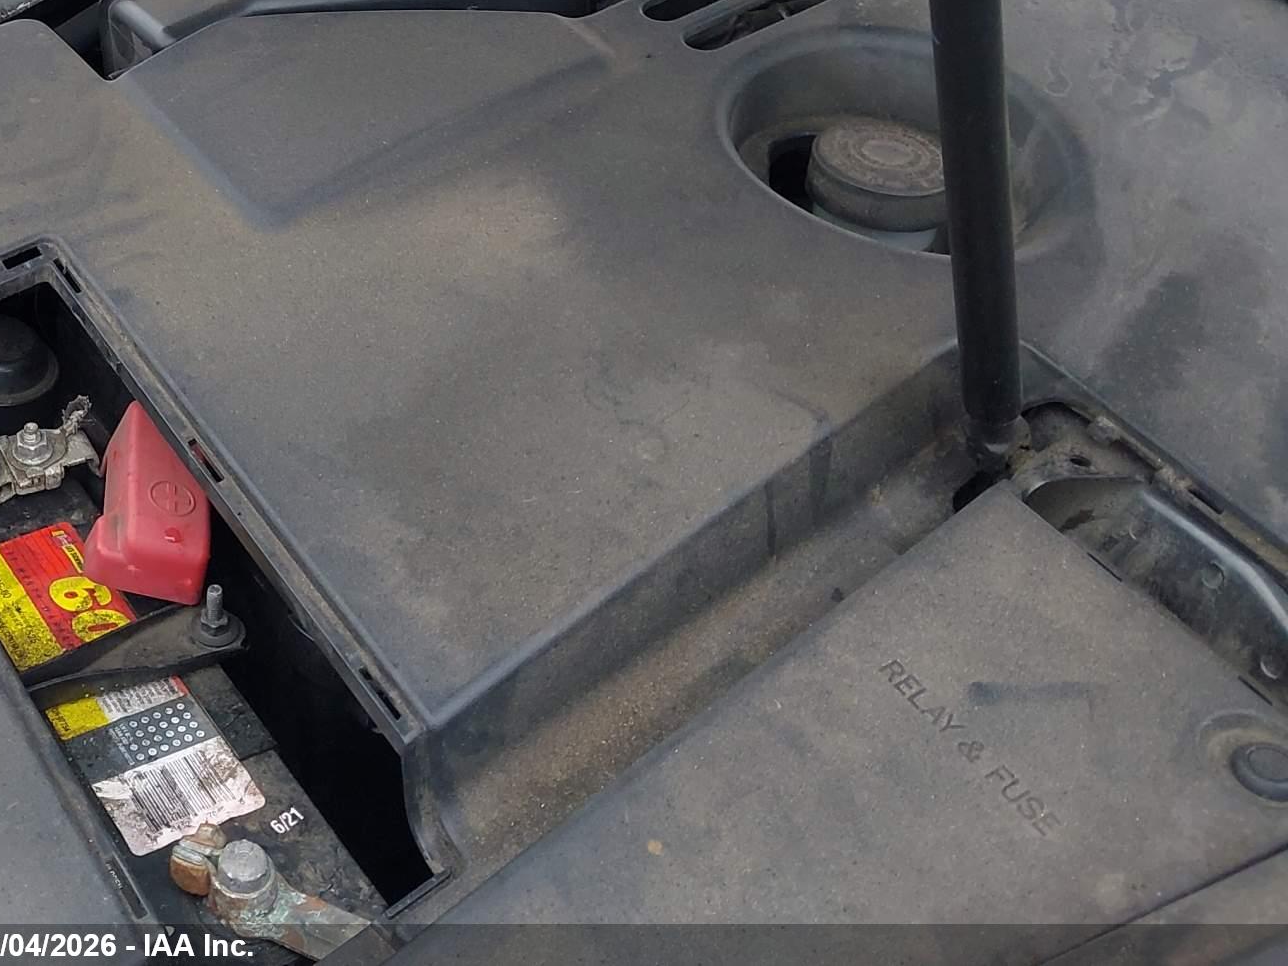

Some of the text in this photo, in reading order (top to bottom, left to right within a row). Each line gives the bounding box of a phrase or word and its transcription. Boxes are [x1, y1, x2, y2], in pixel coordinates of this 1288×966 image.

[48, 576, 131, 643] 60
[878, 659, 1061, 837] RELAY & FUSE
[270, 807, 304, 834] 6/21
